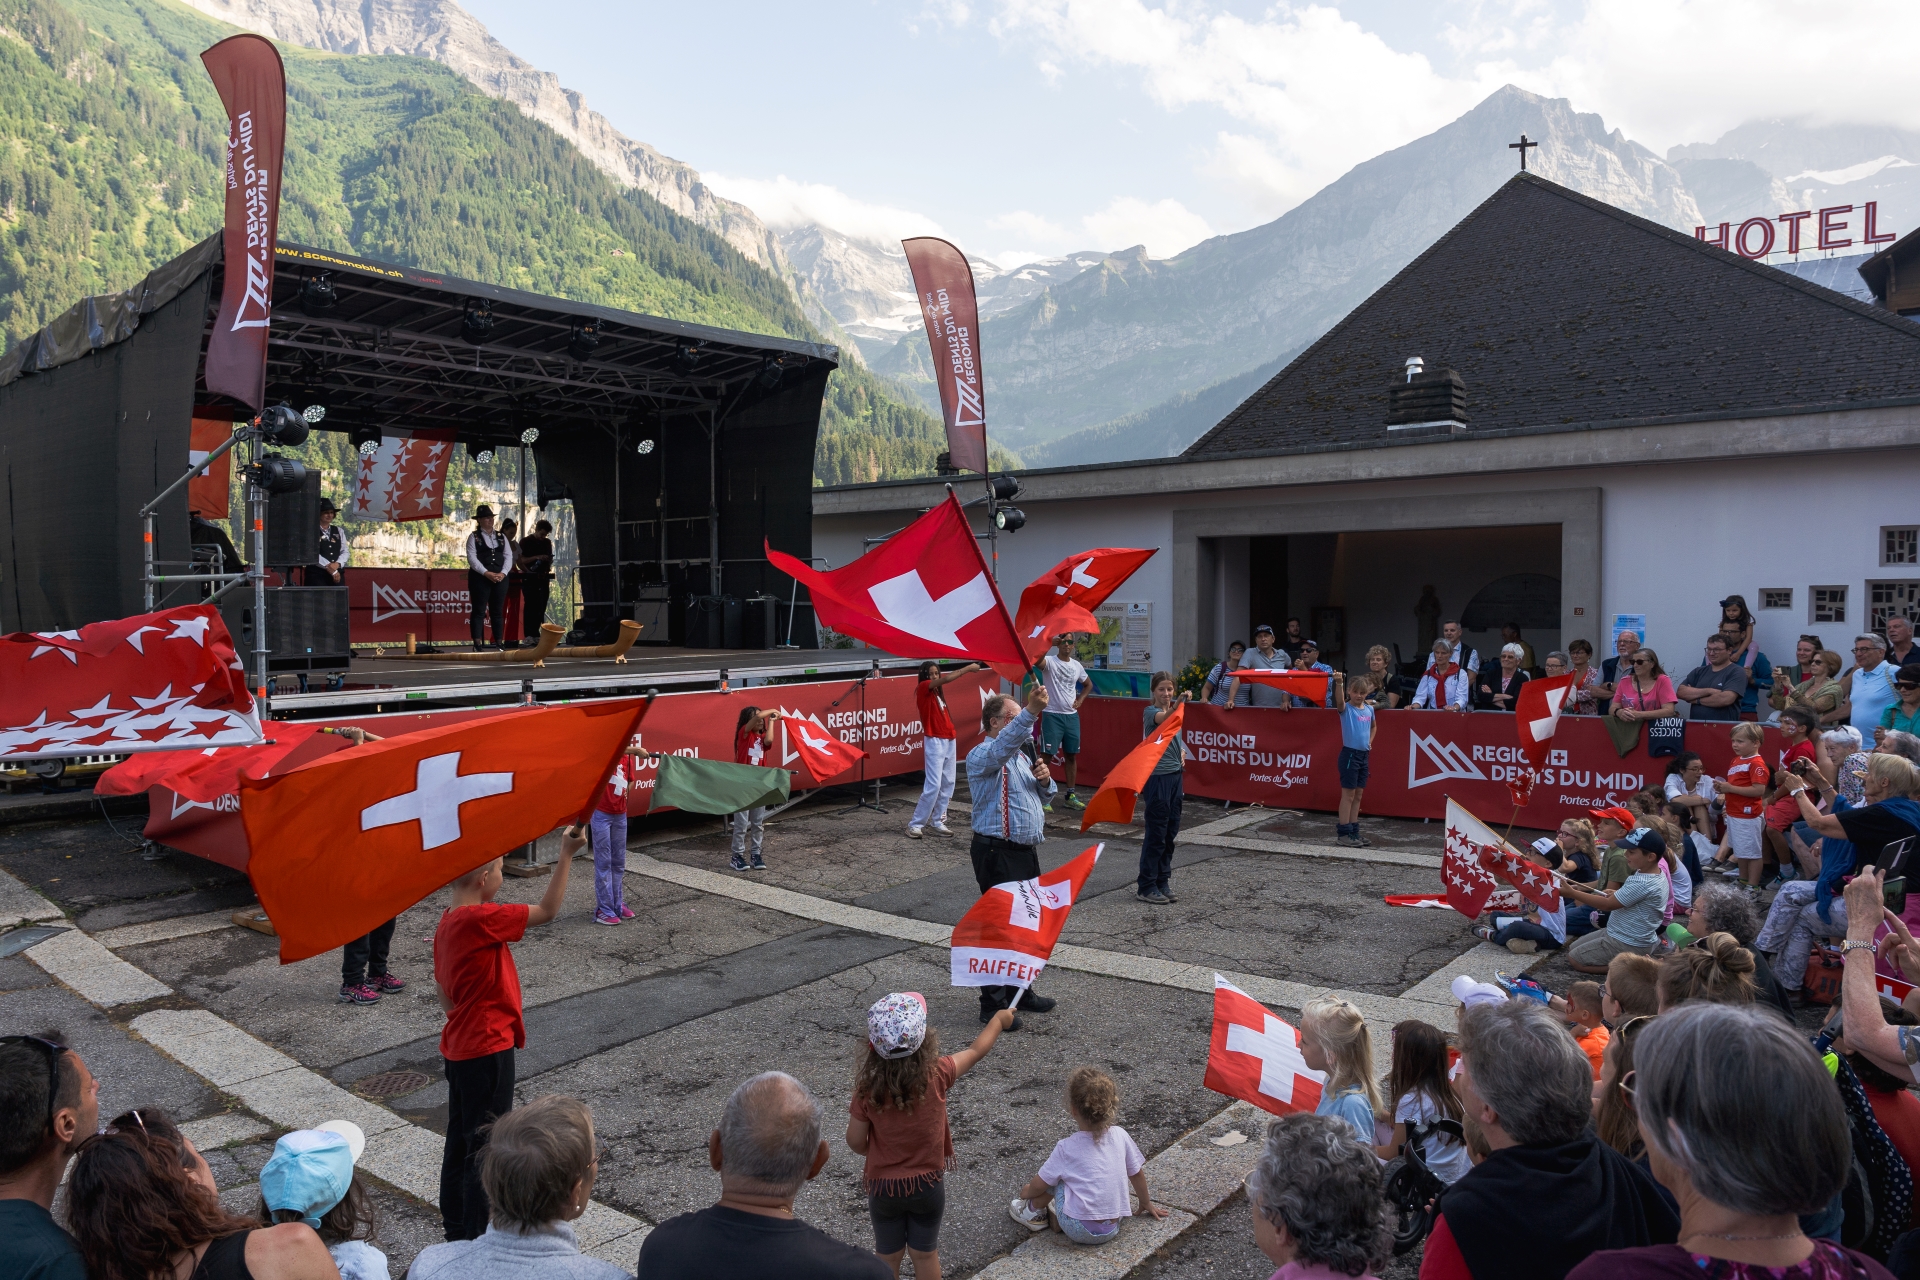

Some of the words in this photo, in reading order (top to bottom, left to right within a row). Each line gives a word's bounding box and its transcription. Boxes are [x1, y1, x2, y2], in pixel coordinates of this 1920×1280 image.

[1695, 201, 1896, 259] HOTEL
[275, 247, 404, 279] ww.scenemobile.ch
[414, 590, 460, 601] REGION
[426, 602, 462, 613] DENTS
[827, 708, 876, 728] REGION
[1655, 717, 1684, 727] MONEY
[840, 725, 879, 744] DENTS
[881, 723, 899, 739] DU
[901, 720, 924, 737] MID
[1186, 730, 1240, 748] REGION
[1650, 727, 1682, 737] SUCCESS
[880, 743, 897, 754] Portes
[897, 743, 905, 752] du
[904, 737, 923, 755] Soleil
[1198, 748, 1246, 765] DENTS
[1249, 752, 1273, 767] DU
[1277, 754, 1311, 769] MIDI
[635, 778, 656, 789] Porte
[1249, 773, 1271, 783] Portes
[1272, 774, 1282, 783] du
[1282, 769, 1309, 789] Soleil
[1560, 770, 1590, 788] DU
[1595, 771, 1644, 790] MIDI
[216, 793, 242, 812] DEN
[1559, 794, 1590, 807] Portes
[1592, 796, 1606, 807] du
